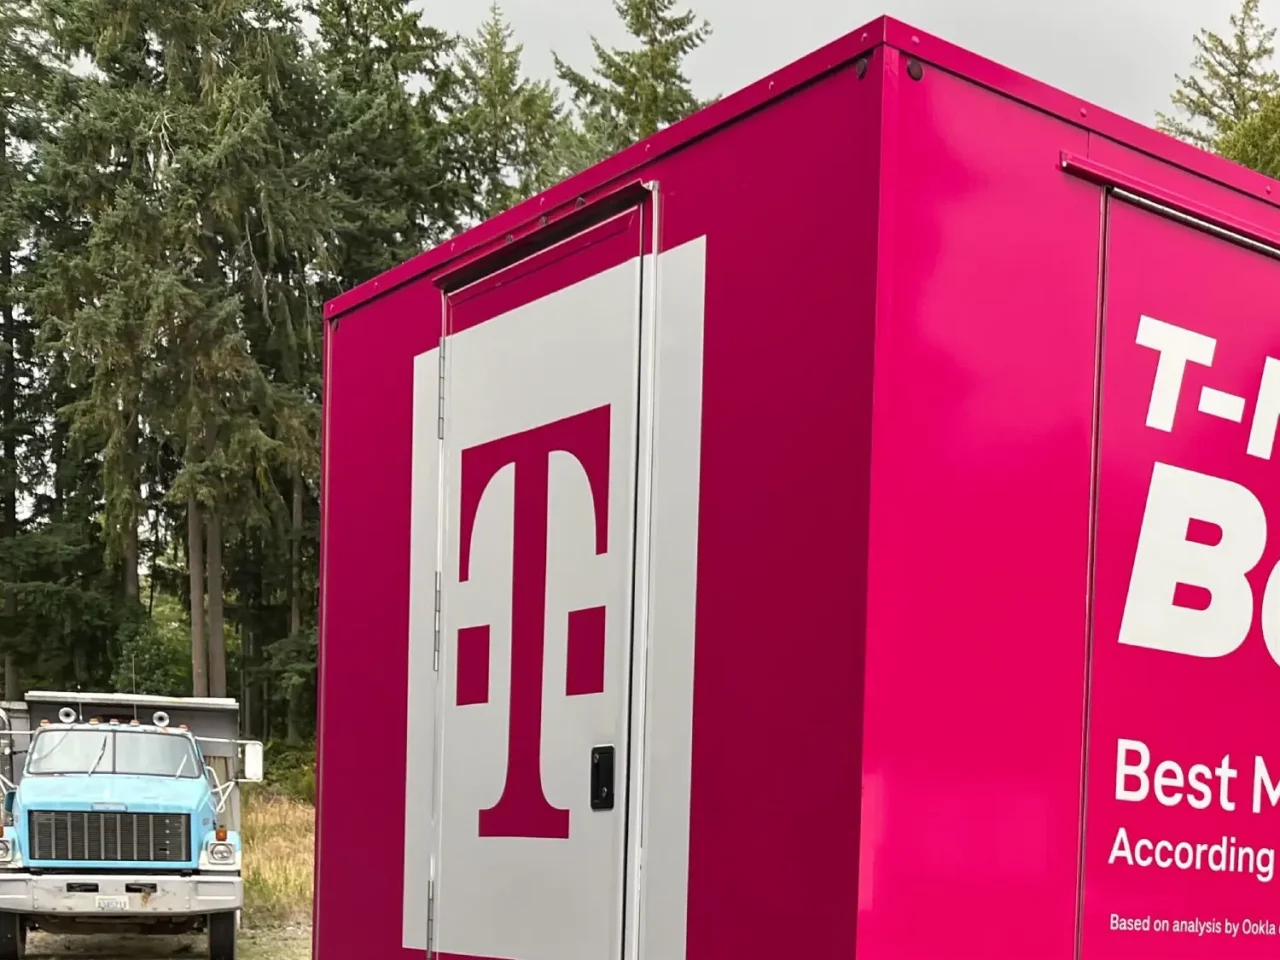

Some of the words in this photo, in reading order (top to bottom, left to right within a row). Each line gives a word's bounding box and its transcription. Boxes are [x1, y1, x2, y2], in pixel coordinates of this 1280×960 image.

[1115, 738, 1238, 812] Best
[1107, 827, 1275, 883] According
[1110, 913, 1150, 931] Based
[1153, 918, 1169, 932] on
[1173, 917, 1221, 936] analysis
[1224, 918, 1240, 938] by
[1242, 919, 1276, 935] Ookla
